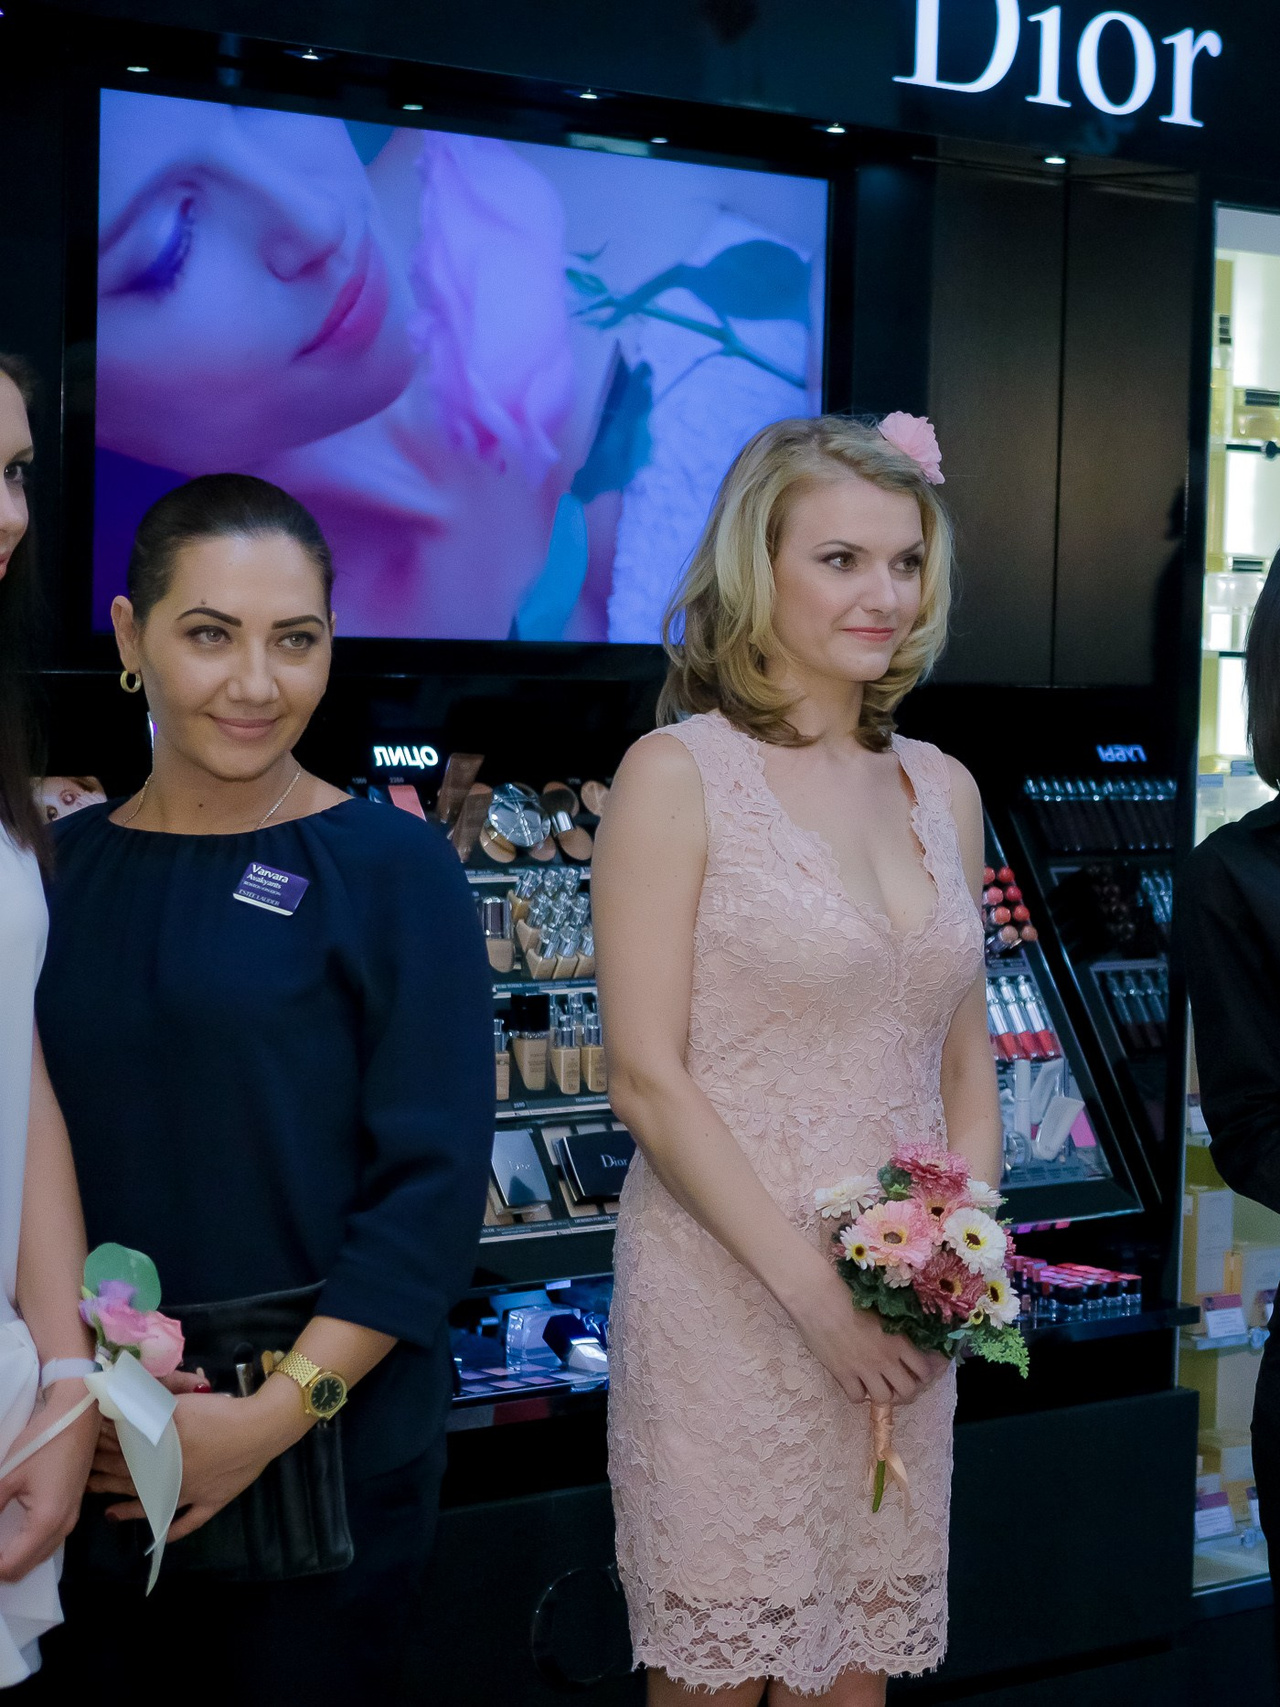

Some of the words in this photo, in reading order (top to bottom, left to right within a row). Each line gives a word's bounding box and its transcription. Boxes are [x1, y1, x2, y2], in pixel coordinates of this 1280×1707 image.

[892, 0, 1223, 127] Dior
[252, 863, 289, 883] Varvara
[600, 1154, 628, 1169] Dior
